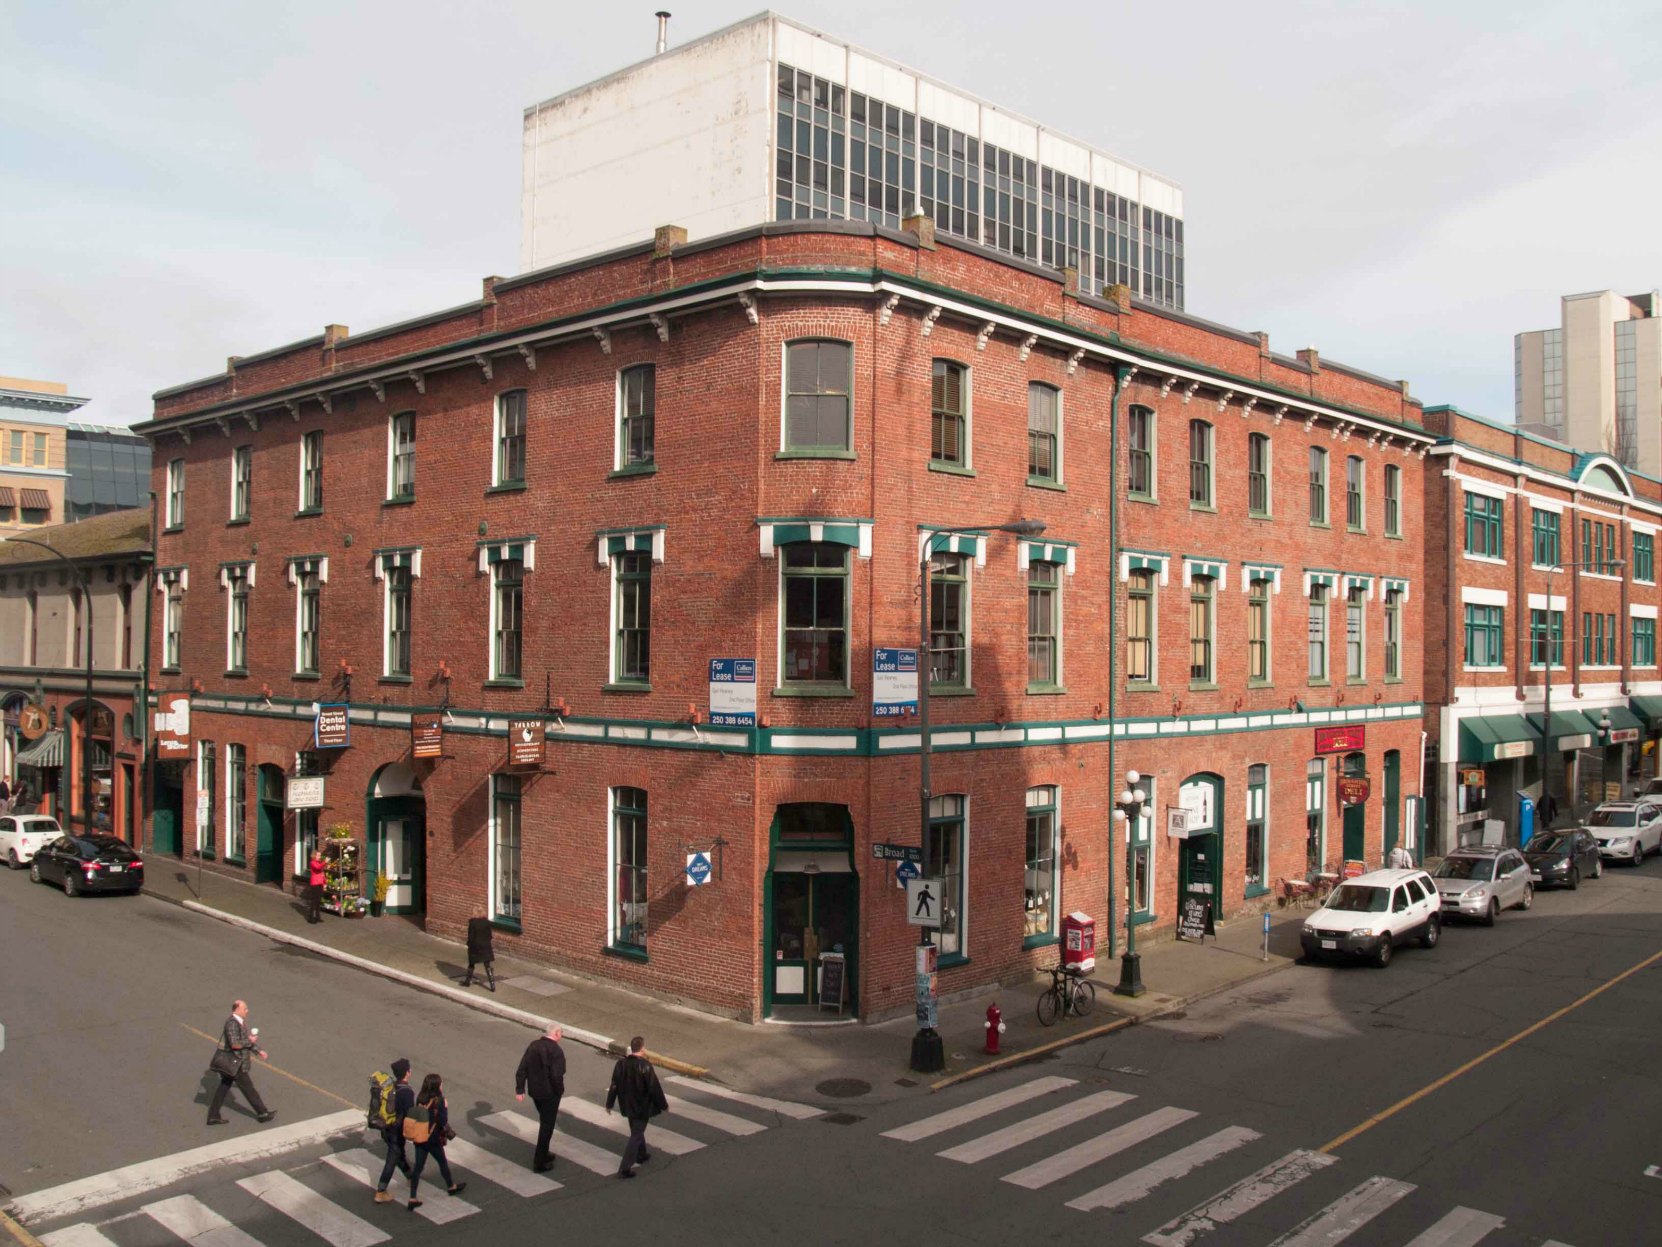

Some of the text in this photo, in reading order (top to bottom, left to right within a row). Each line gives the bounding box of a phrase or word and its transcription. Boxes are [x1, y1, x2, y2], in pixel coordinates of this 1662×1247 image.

[876, 650, 887, 660] For
[712, 660, 724, 670] For
[876, 661, 896, 671] Lease
[712, 671, 732, 681] Lease
[875, 705, 888, 715] 250
[888, 705, 900, 715] 388
[320, 715, 346, 724] Dental
[712, 715, 753, 725] 250 388 6454
[320, 723, 346, 732] Centre
[514, 721, 541, 729] YARROW
[884, 847, 905, 858] Broad
